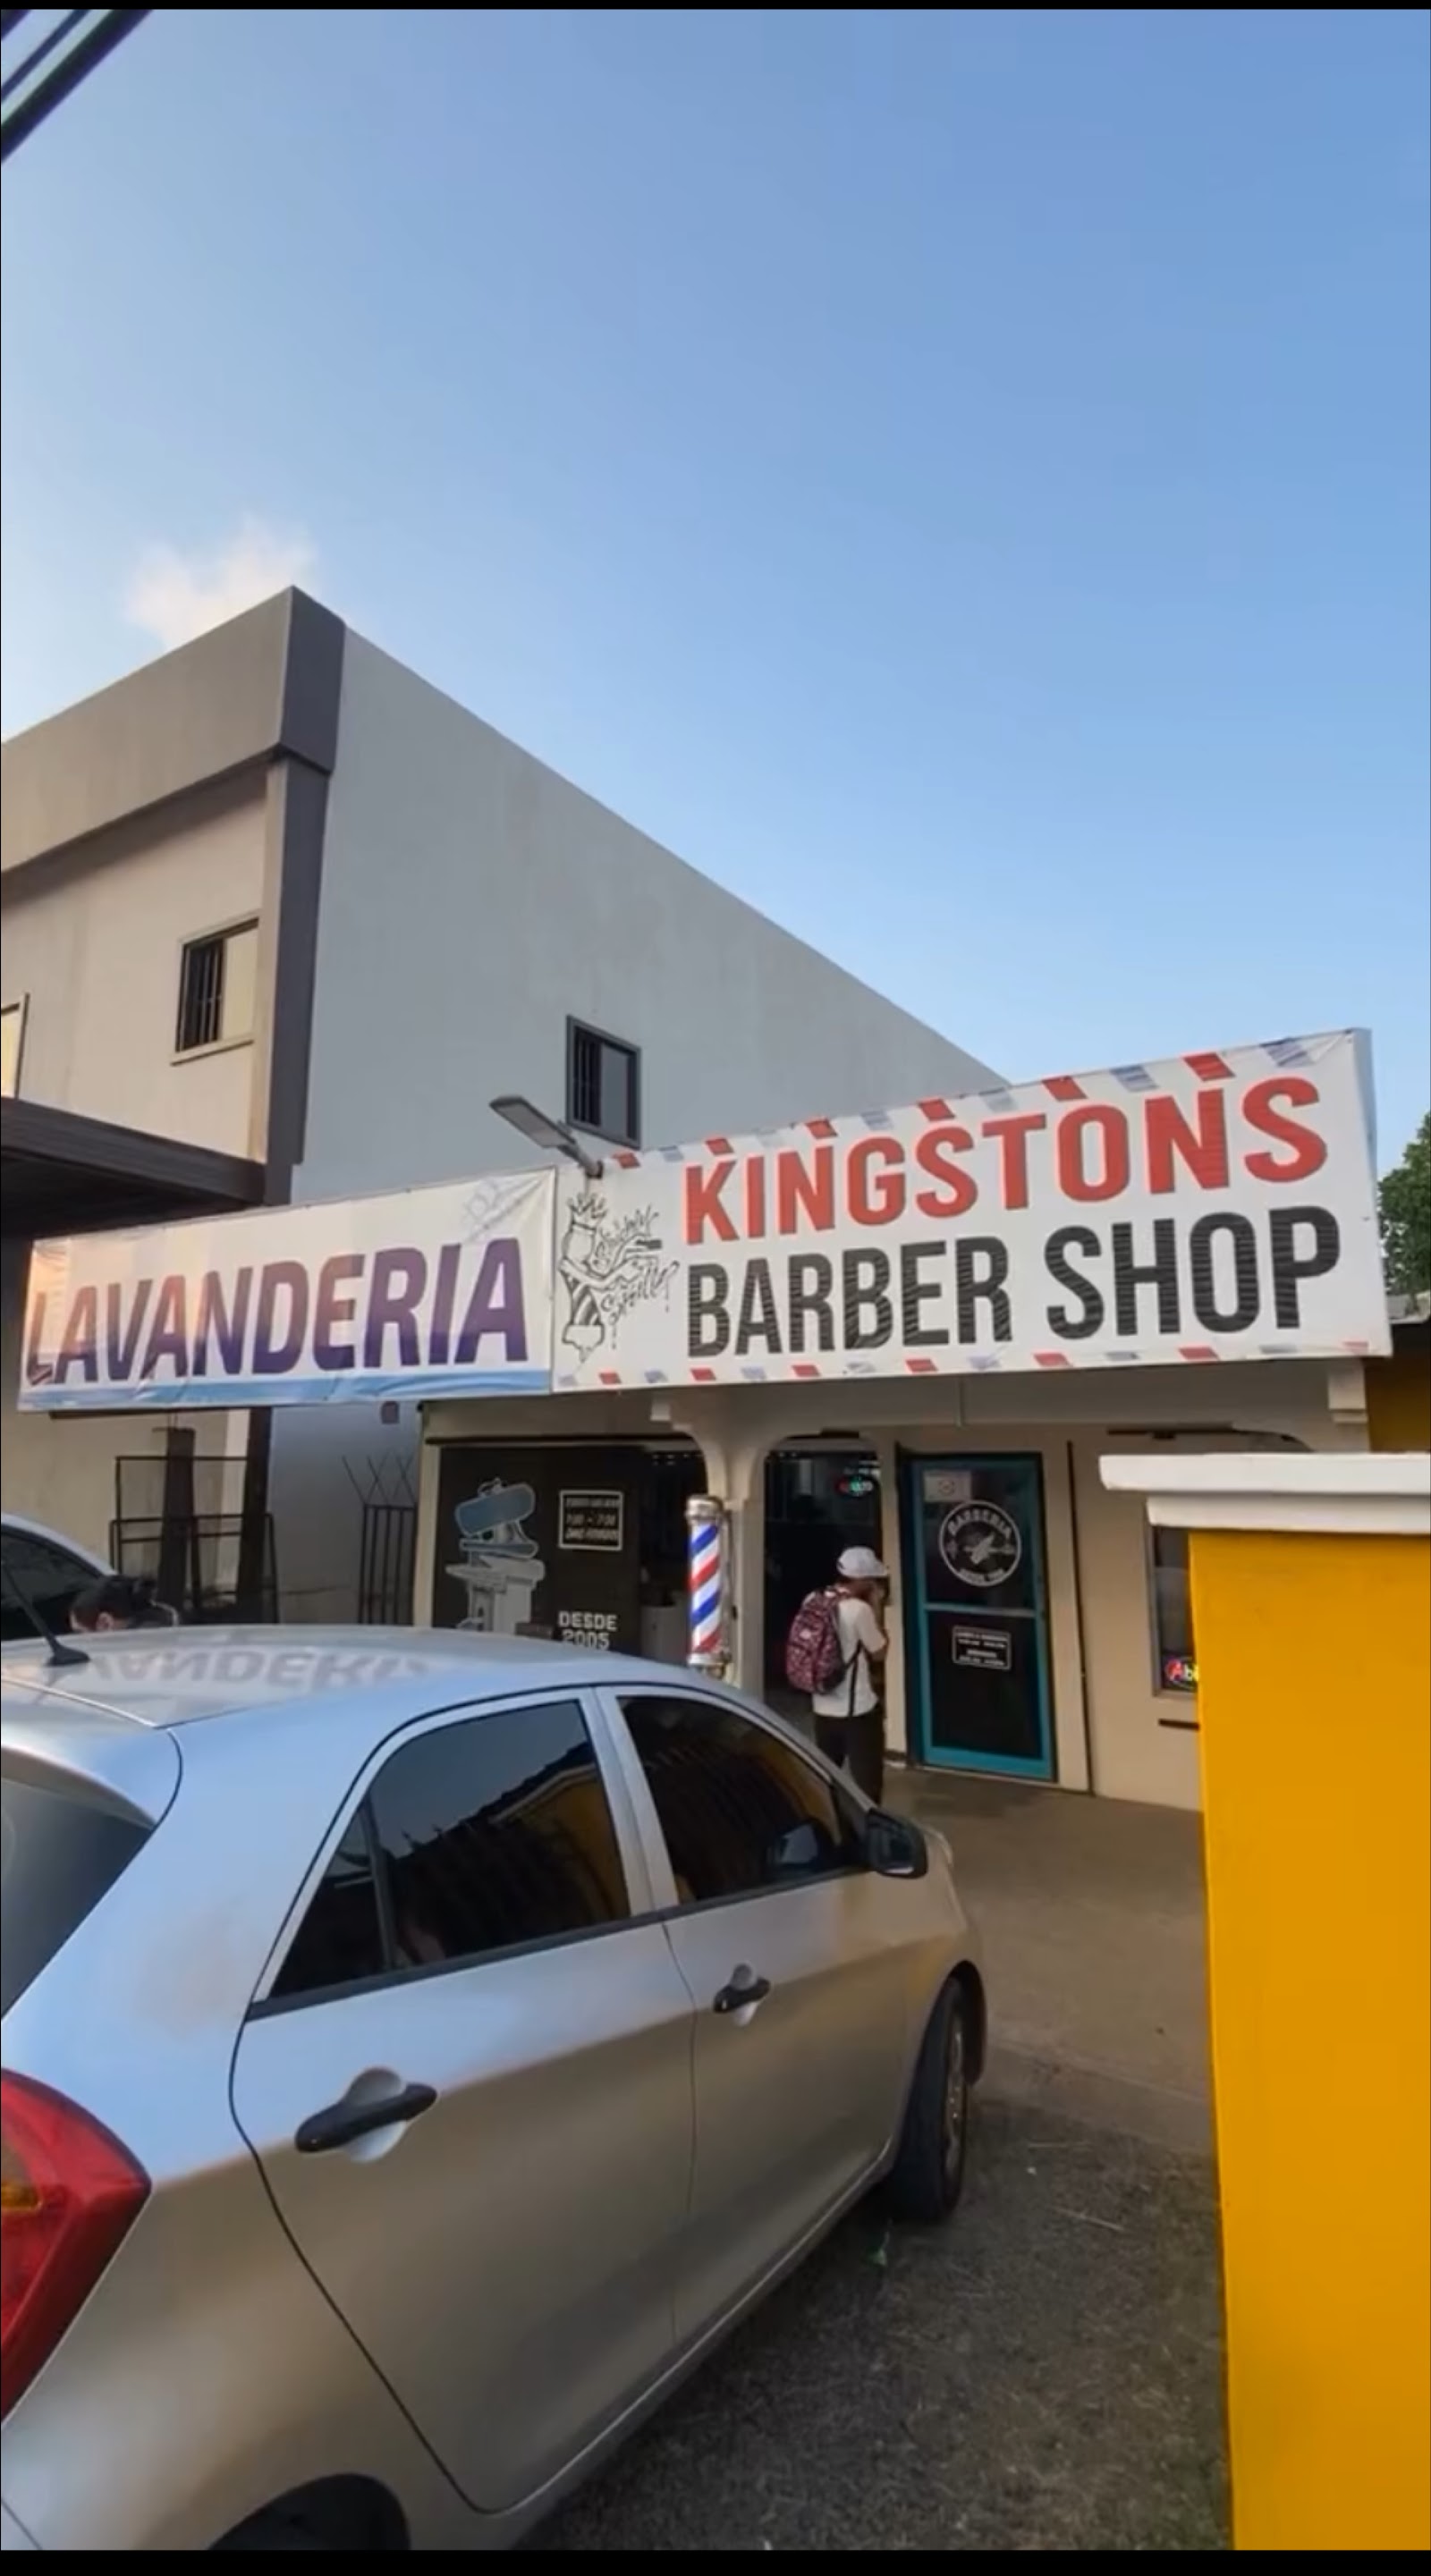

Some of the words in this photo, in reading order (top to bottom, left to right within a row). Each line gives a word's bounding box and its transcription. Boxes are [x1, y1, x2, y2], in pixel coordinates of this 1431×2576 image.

[684, 1076, 1329, 1246] KINGSTONS
[26, 1237, 529, 1387] LAVANDERIA
[687, 1236, 1013, 1357] BARBER
[1043, 1205, 1342, 1339] SHOP
[559, 1610, 617, 1632] DESDE
[563, 1629, 610, 1651] 2005
